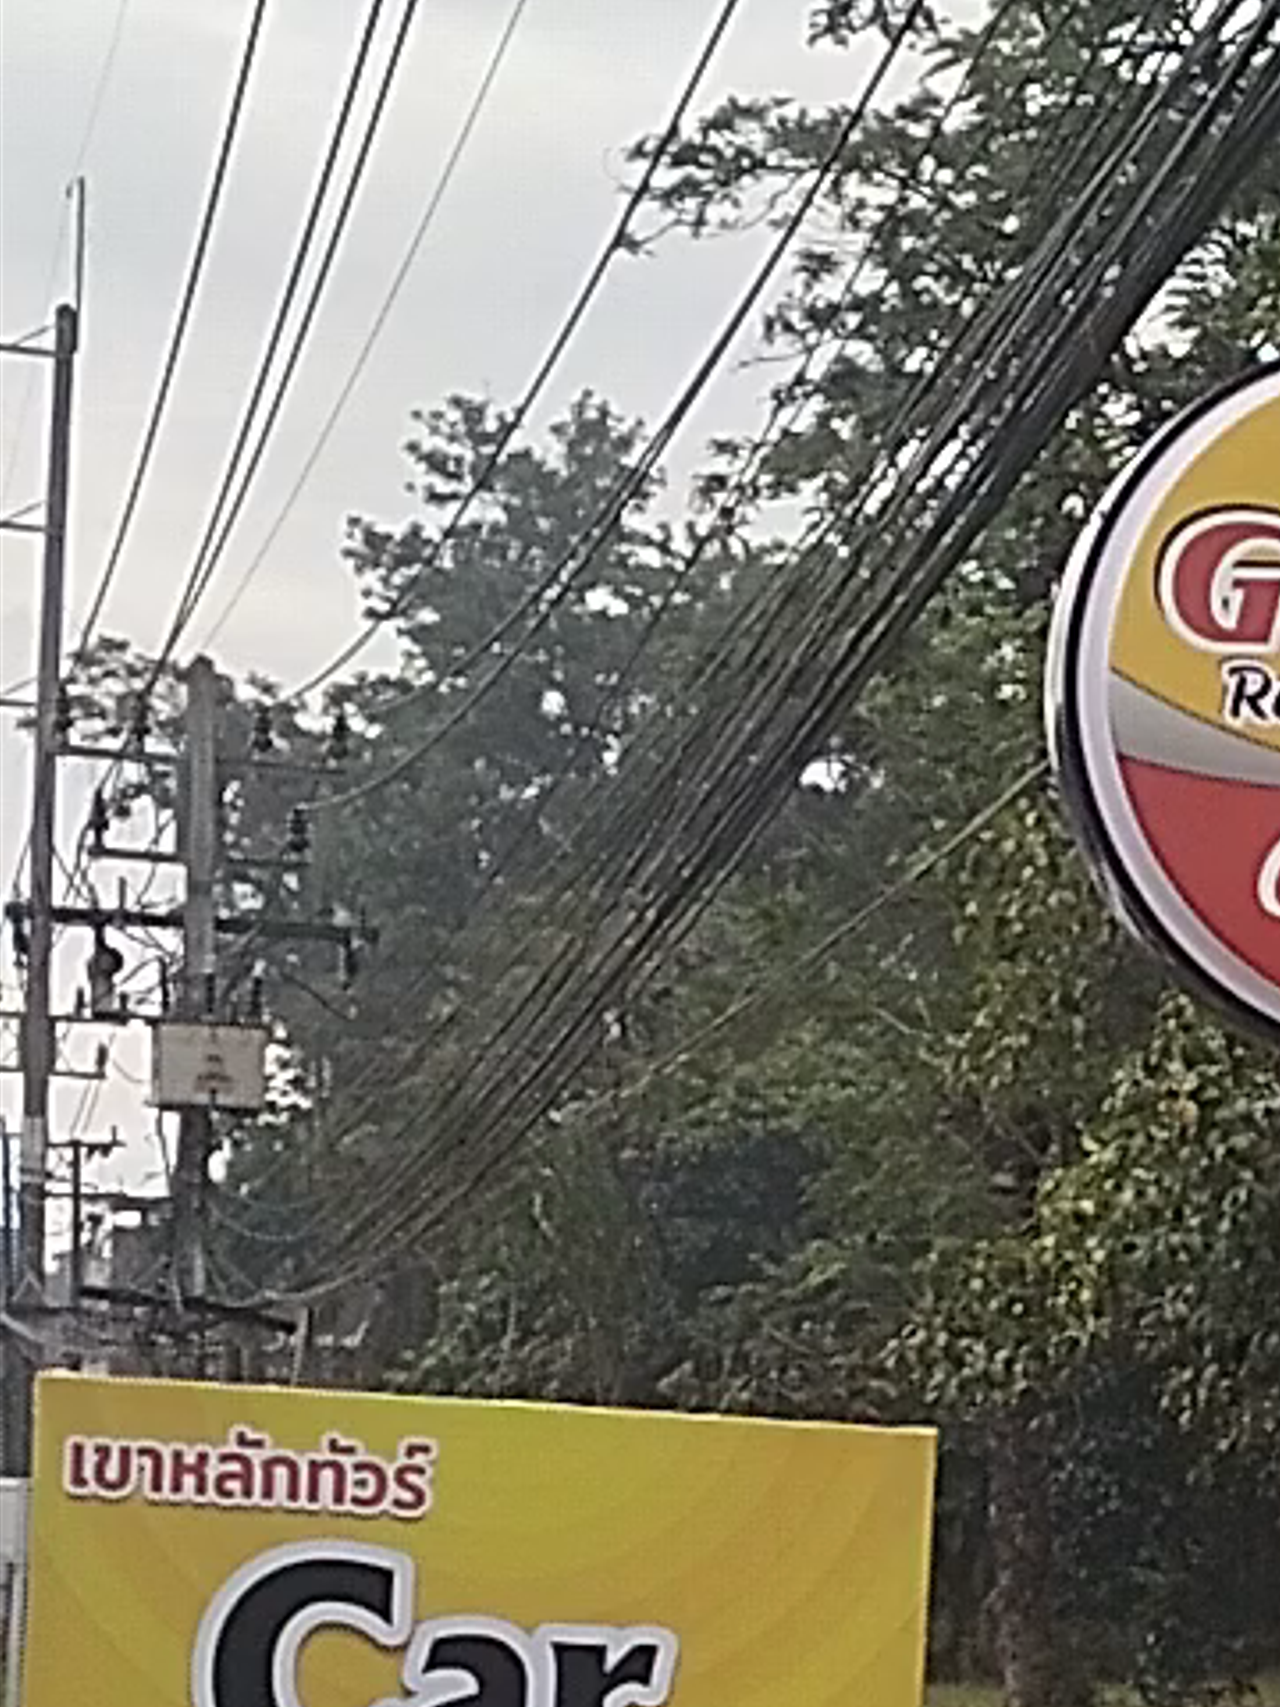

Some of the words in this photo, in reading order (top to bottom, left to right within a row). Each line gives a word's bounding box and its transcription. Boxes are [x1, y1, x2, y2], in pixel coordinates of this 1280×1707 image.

[67, 1432, 434, 1515] เขาหลักทัวร์
